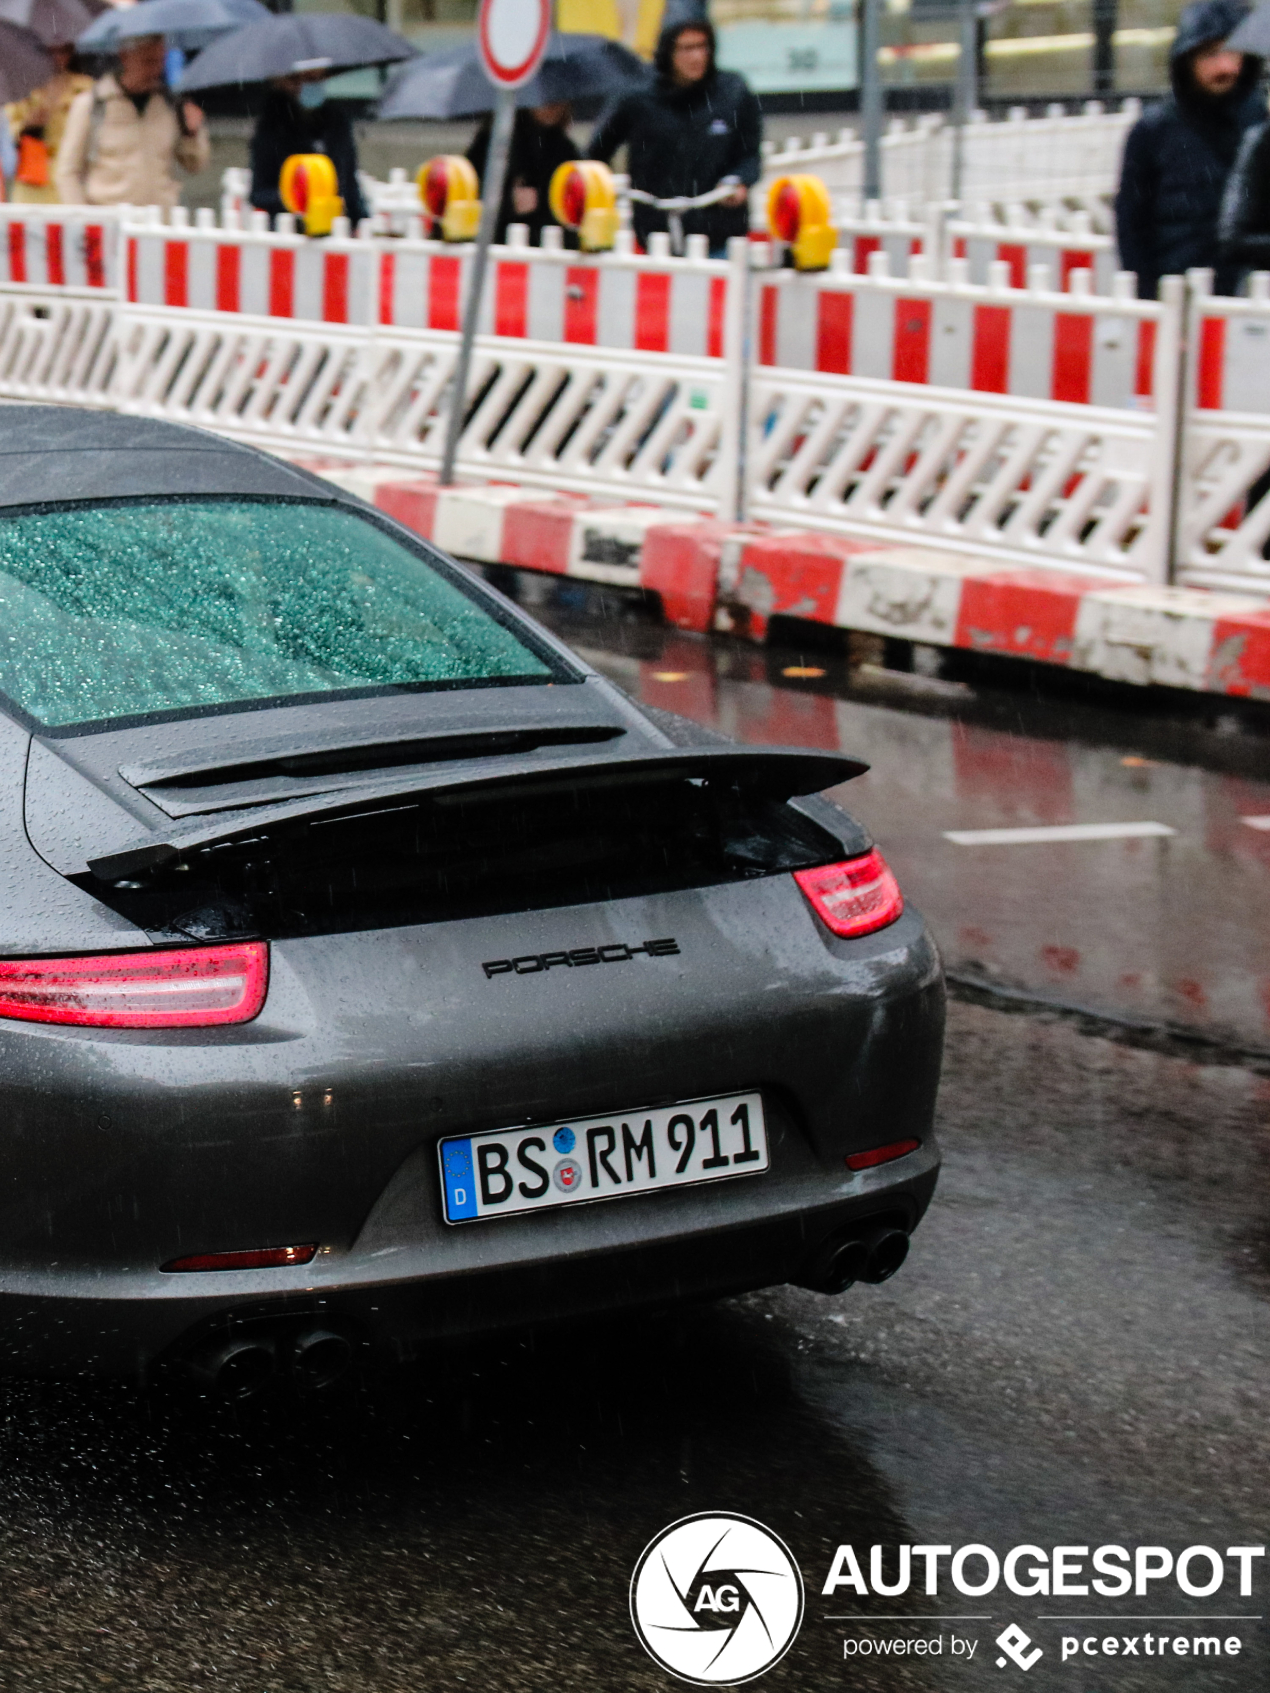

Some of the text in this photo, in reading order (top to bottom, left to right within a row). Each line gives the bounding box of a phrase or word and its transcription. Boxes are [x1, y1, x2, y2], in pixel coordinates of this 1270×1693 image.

[482, 938, 681, 979] PORSCHE
[477, 1103, 760, 1205] BS RM 911
[454, 1188, 467, 1206] D
